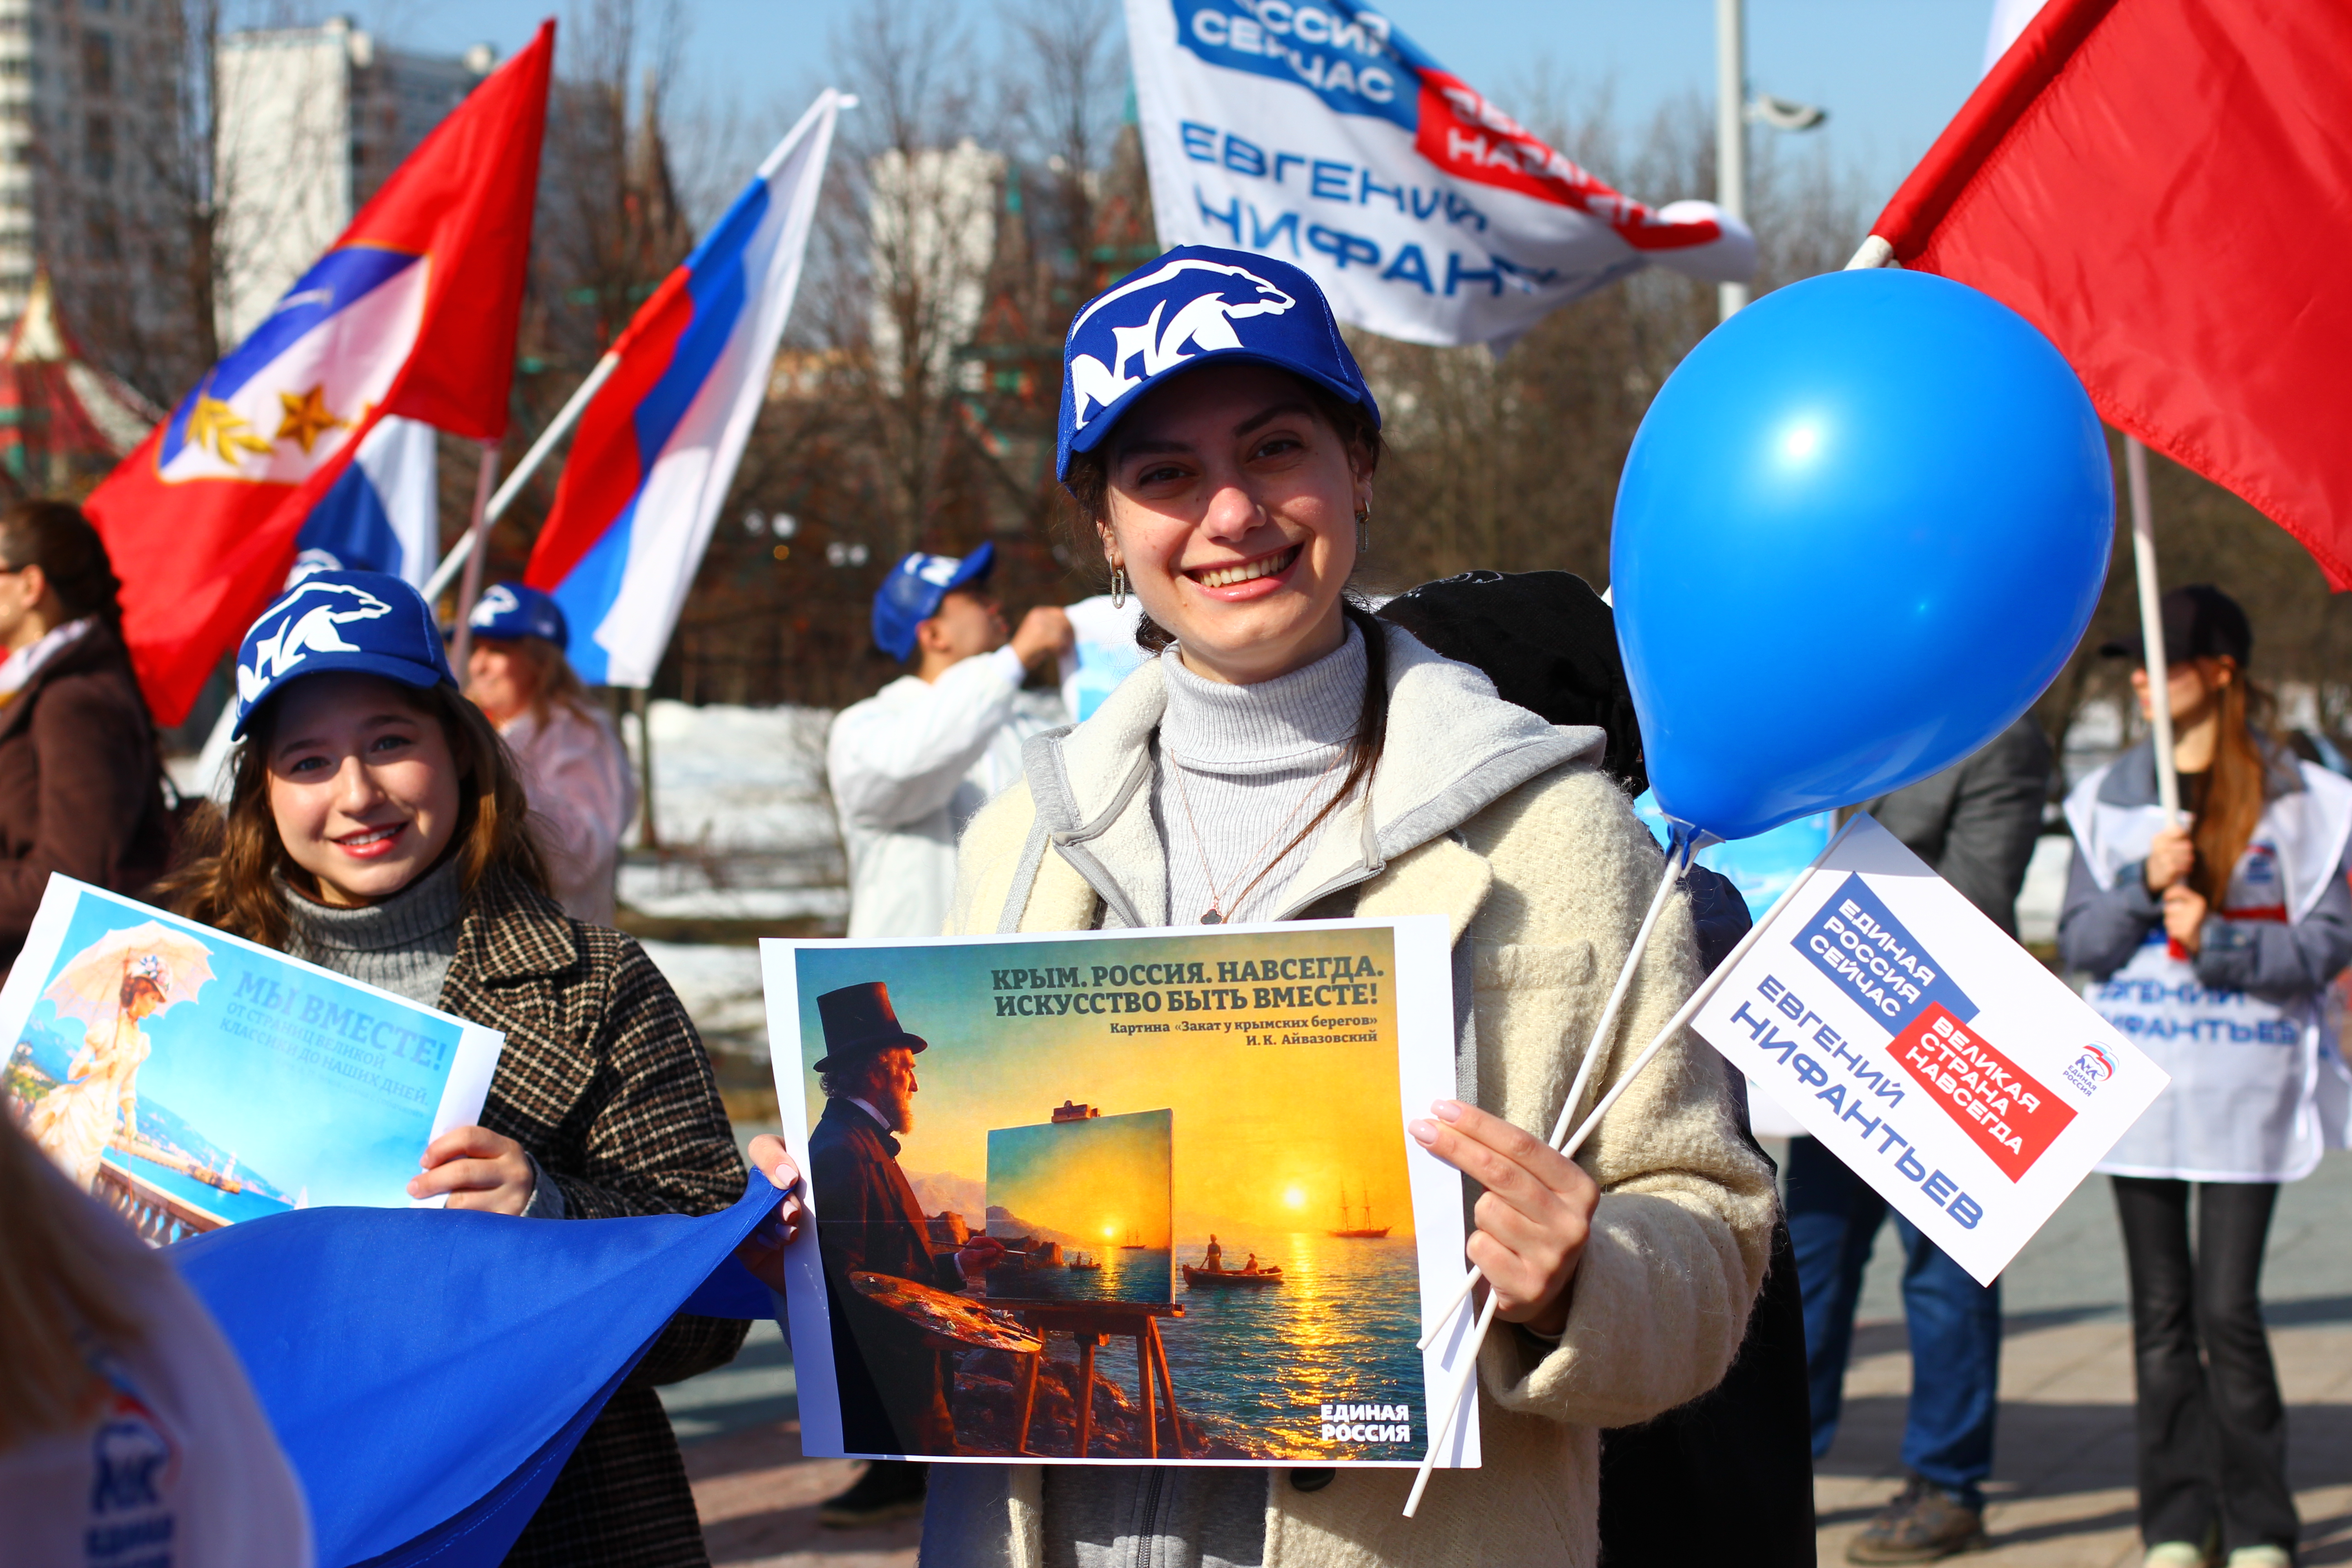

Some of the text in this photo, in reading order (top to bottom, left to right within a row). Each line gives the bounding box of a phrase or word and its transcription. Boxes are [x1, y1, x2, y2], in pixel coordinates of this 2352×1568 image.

[1823, 917, 1921, 1004] РОССИЯ
[1838, 898, 1936, 986] ЕДИНАЯ
[991, 956, 1384, 990] КРЫМ. РОССИЯ. НАВСЕГДА.
[995, 983, 1377, 1017] ИСКУССТВО БЫТЬ ВМЕСТЕ!
[1809, 935, 1901, 1017] СЕЙЧАС
[227, 1002, 246, 1017] ОТ
[314, 1033, 386, 1070] ВЕЛИКОЙ
[232, 971, 447, 1071] МЫ ВМЕСТЕ!
[1110, 1015, 1377, 1034] Картина «Закат у крымских берегов»
[1246, 1030, 1377, 1046] И. К. Айвазовский
[1756, 975, 1905, 1108] ЕВГЕНИЙ
[2102, 1013, 2297, 1044] ИФАНТЬЕВ
[297, 1045, 319, 1065] ДО
[322, 1058, 381, 1088] НАШИХ
[1920, 1033, 2009, 1117] СТРАНА
[1931, 1015, 2040, 1114] ВЕЛИКАЯ
[2063, 1070, 2092, 1097] РОССИЯ
[2068, 1064, 2097, 1091] ЕДИНАЯ
[1730, 1001, 1983, 1230] НИФАНТЬЕВ
[1905, 1046, 2024, 1155] НАВСЕГДА
[1321, 1404, 1409, 1422] ЕДИНАЯ
[1321, 1424, 1411, 1442] РОССИЯ
